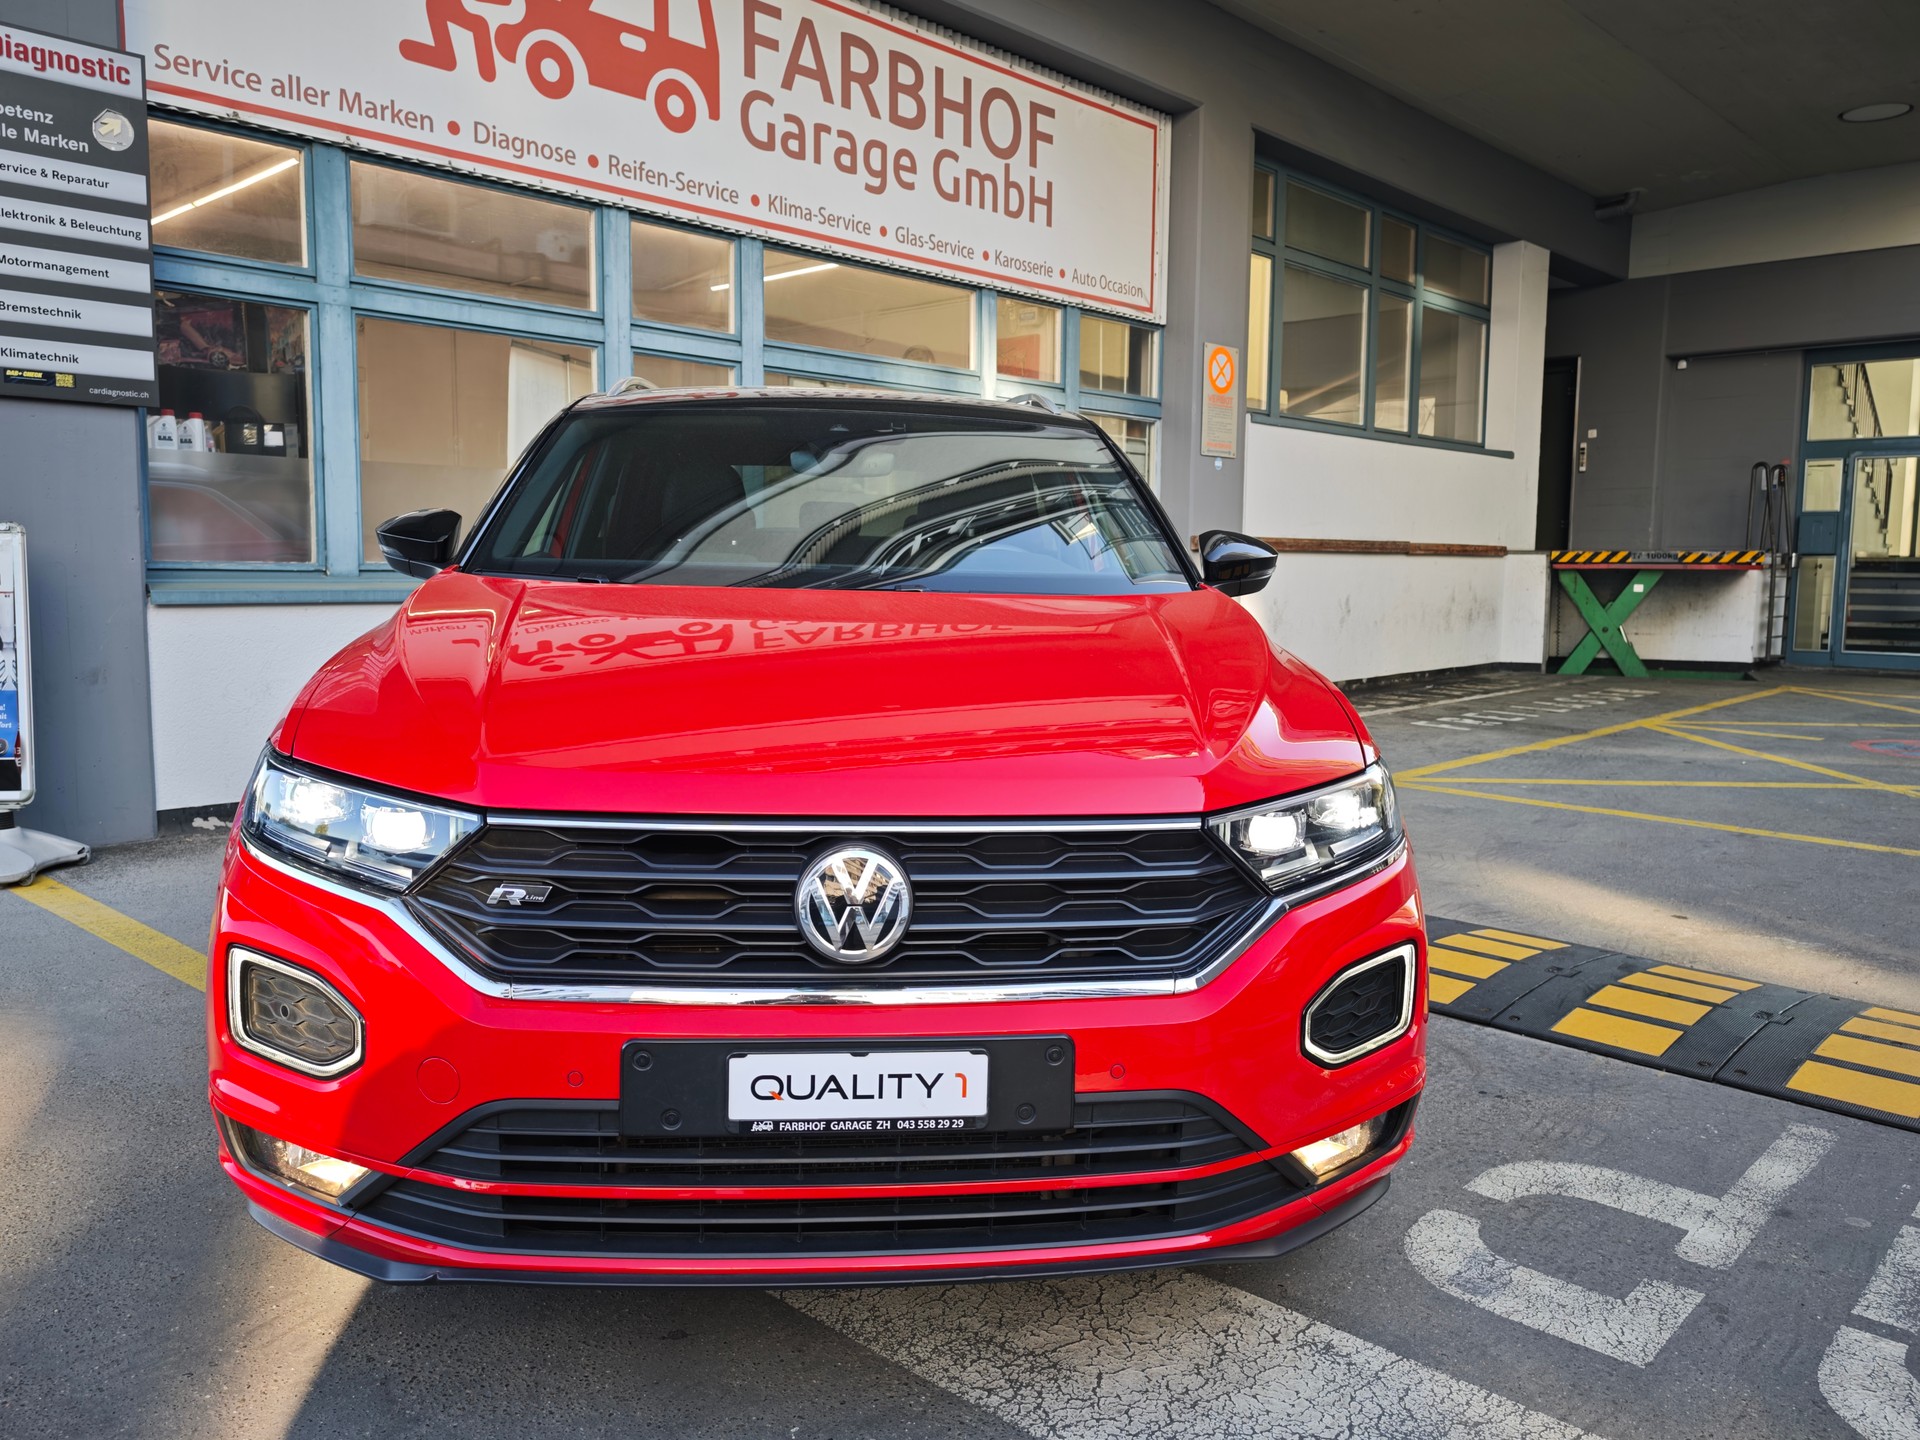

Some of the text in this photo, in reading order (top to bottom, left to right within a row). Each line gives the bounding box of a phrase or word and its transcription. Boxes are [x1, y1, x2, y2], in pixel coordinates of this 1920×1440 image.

[154, 43, 434, 134] Service aller Marken
[743, 0, 1056, 169] FARBHOF
[0, 123, 89, 153] le Marken
[473, 121, 577, 167] Diagnose
[740, 88, 1054, 228] Garage GmbH
[40, 168, 49, 179] &
[52, 170, 110, 189] Reparatur
[608, 155, 739, 205] Reifen-Service
[0, 208, 142, 241] lektronik & Beleuchtung
[768, 193, 871, 237] Klima-Service
[895, 226, 975, 261] Glas-Service
[0, 254, 110, 278] Motormanagement
[994, 249, 1053, 279] Karosserie
[1072, 268, 1144, 299] Auto Occasion
[0, 301, 82, 320] Bremstechnik
[1, 347, 79, 365] Klimatechnik
[89, 386, 150, 400] cardiagnostic.ch
[750, 1072, 968, 1101] QUALITY 1
[779, 1118, 964, 1132] FARBHOF GARAGE ZH 043 558 29 29
